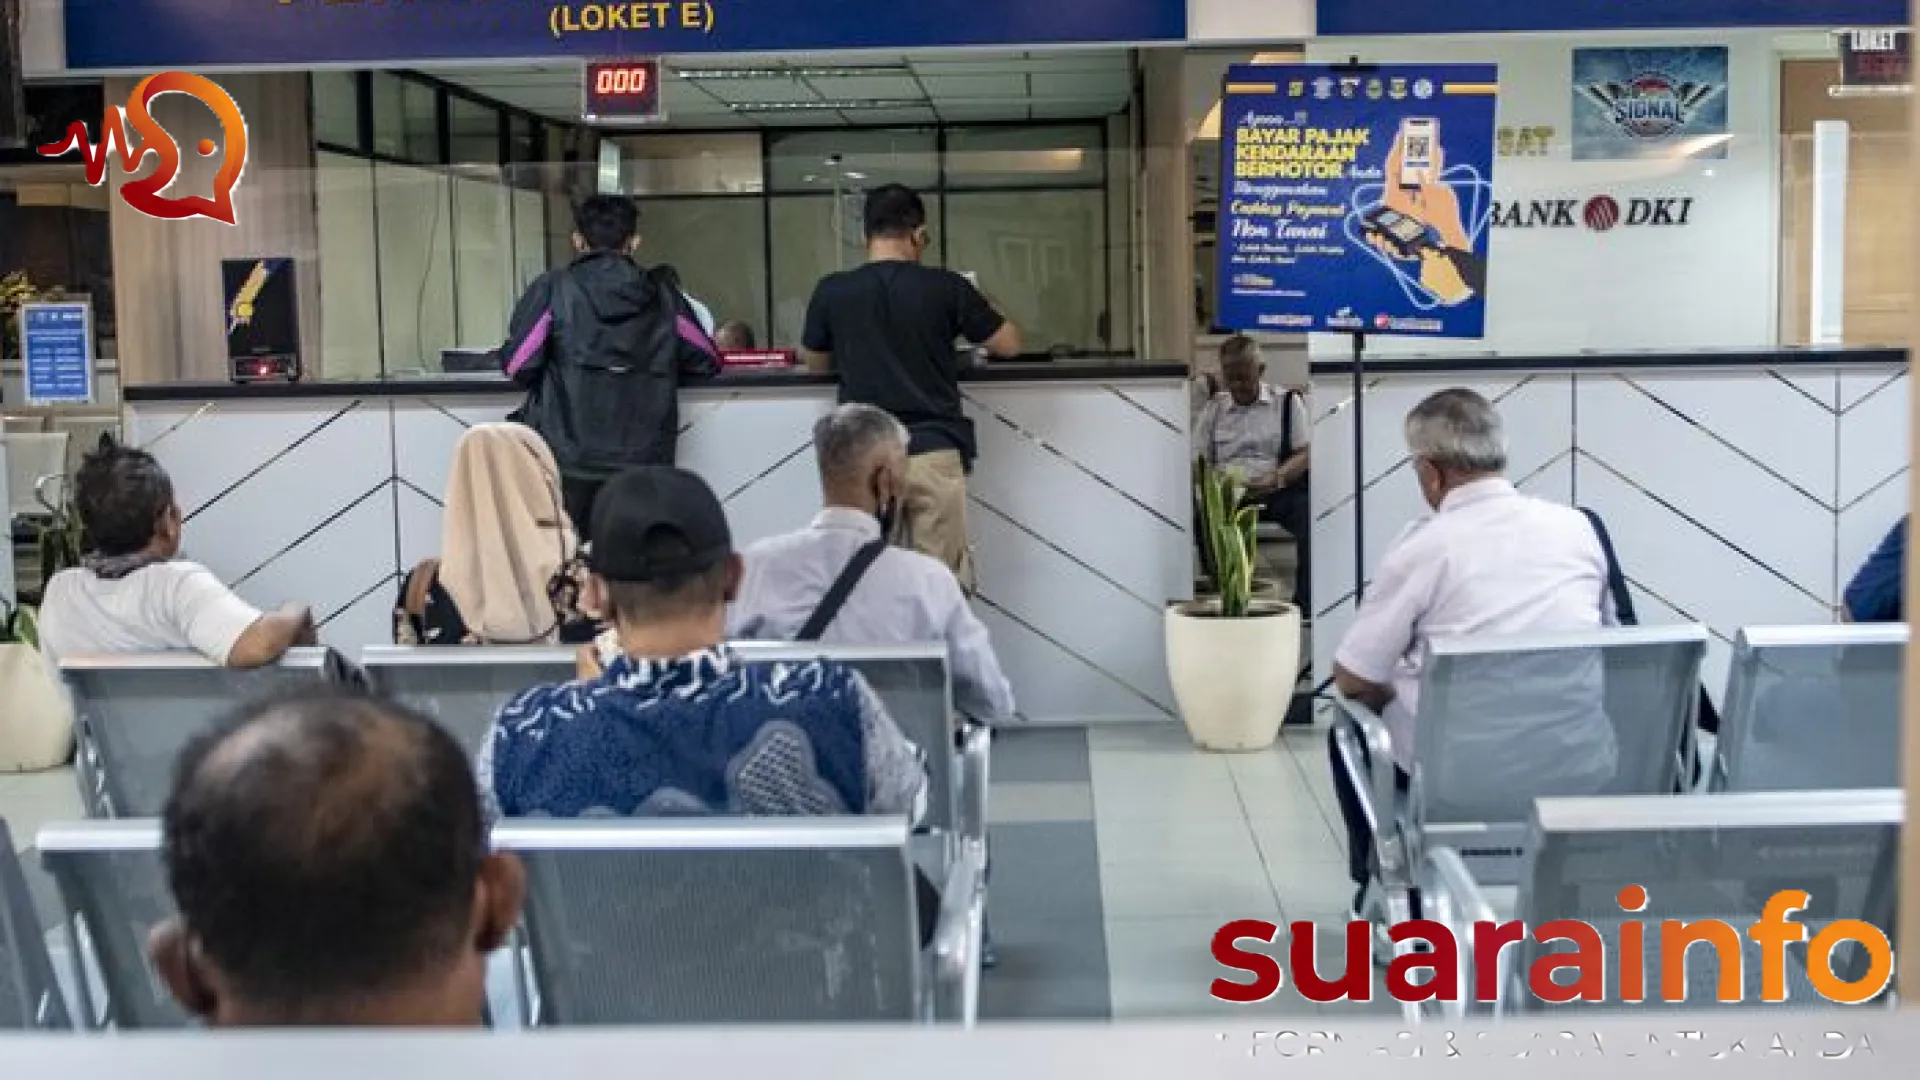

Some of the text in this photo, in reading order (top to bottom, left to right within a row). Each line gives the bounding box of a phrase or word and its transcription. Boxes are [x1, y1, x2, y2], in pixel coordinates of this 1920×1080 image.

[549, 2, 714, 37] (LOKET E)
[596, 69, 647, 94] 000
[1236, 127, 1370, 145] BAYAR PAJAK
[1235, 161, 1342, 178] BERMOTOR
[1491, 196, 1694, 228] BANK DKI
